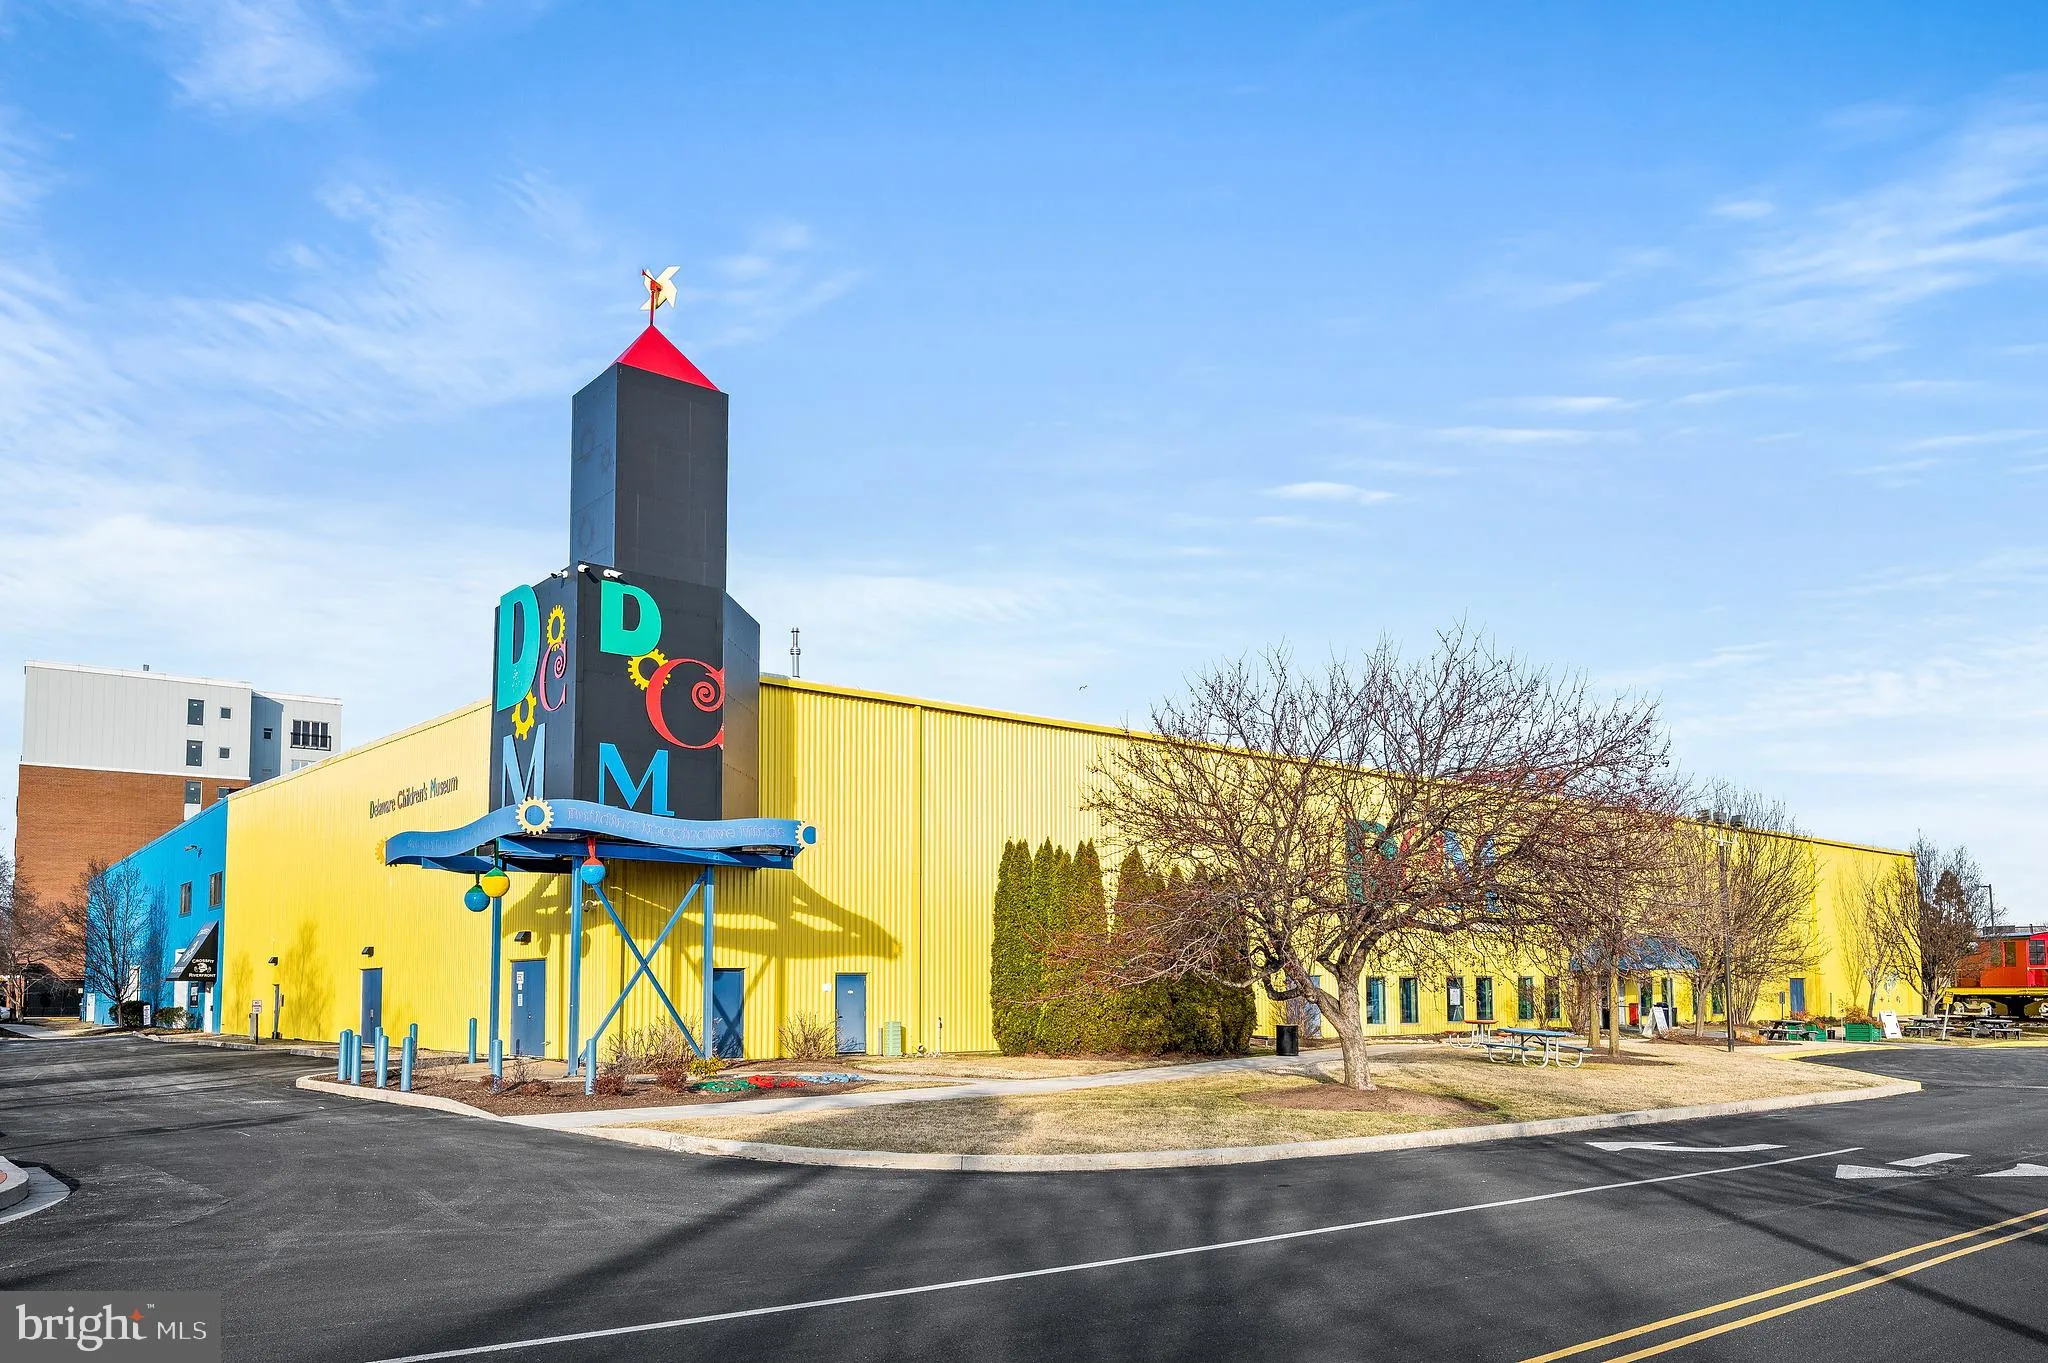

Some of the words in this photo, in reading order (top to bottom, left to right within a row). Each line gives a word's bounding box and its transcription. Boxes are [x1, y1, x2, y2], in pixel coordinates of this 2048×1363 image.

[497, 584, 541, 712] D
[600, 579, 662, 657] D
[369, 799, 396, 819] Delaware
[397, 783, 428, 809] Children's
[430, 776, 459, 799] Museum
[501, 722, 546, 808] M
[599, 742, 675, 816] M
[738, 825, 786, 840] Minds
